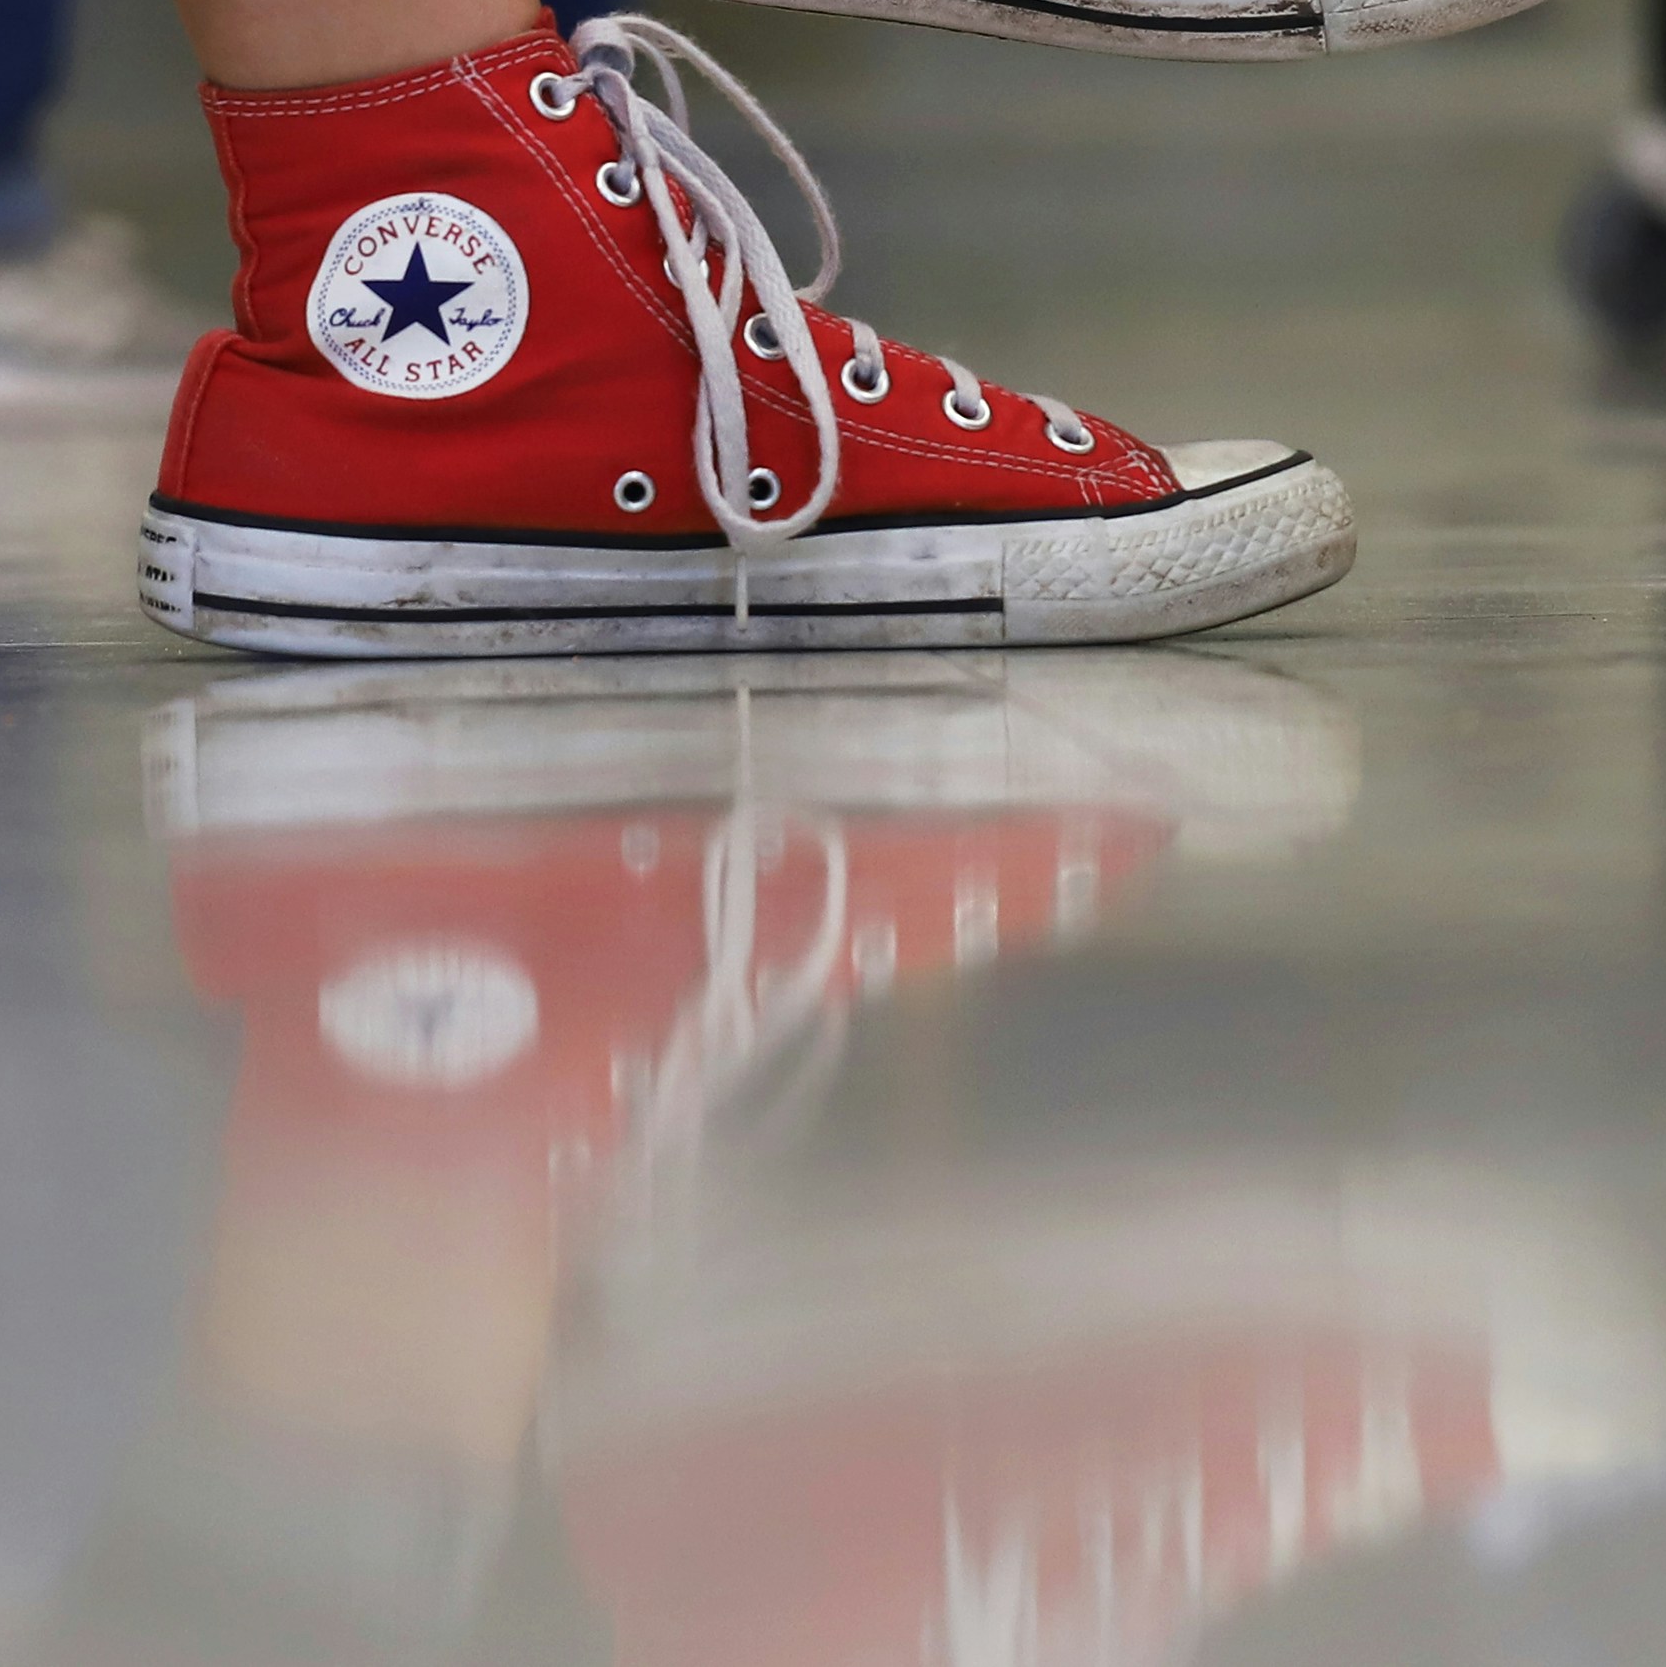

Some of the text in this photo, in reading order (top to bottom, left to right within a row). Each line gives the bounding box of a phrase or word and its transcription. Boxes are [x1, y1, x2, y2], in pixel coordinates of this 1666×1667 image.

[344, 215, 497, 276] CONVERSE
[329, 307, 386, 329] Chuck
[344, 337, 485, 383] ALL STAR
